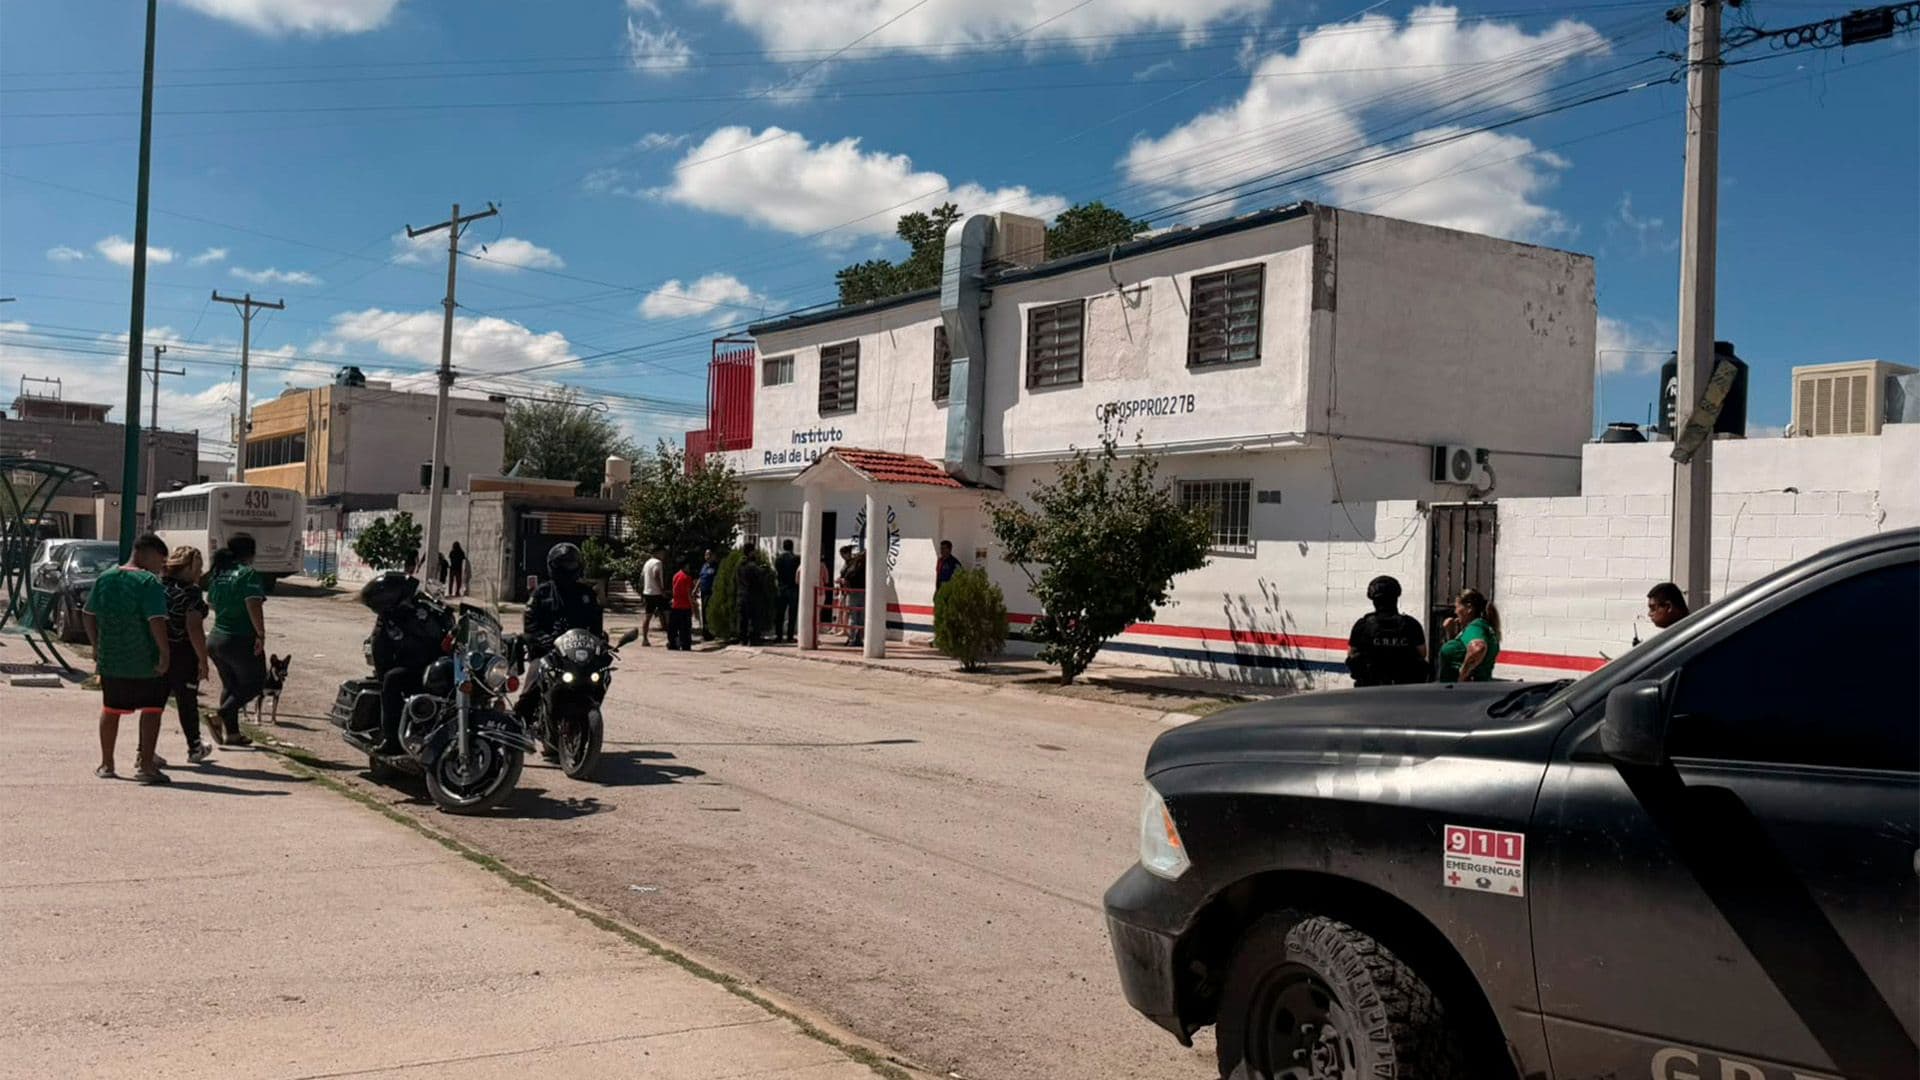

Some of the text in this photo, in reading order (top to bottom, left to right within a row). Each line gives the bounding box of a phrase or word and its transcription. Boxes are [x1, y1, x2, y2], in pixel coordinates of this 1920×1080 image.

[1096, 394, 1195, 421] C05PPR0227B
[791, 426, 843, 444] Instituto
[764, 449, 787, 465] Real
[788, 448, 801, 463] de
[804, 447, 817, 462] La
[245, 490, 269, 509] 430
[1452, 832, 1514, 857] 911
[1446, 860, 1521, 877] EMERGENCIAS
